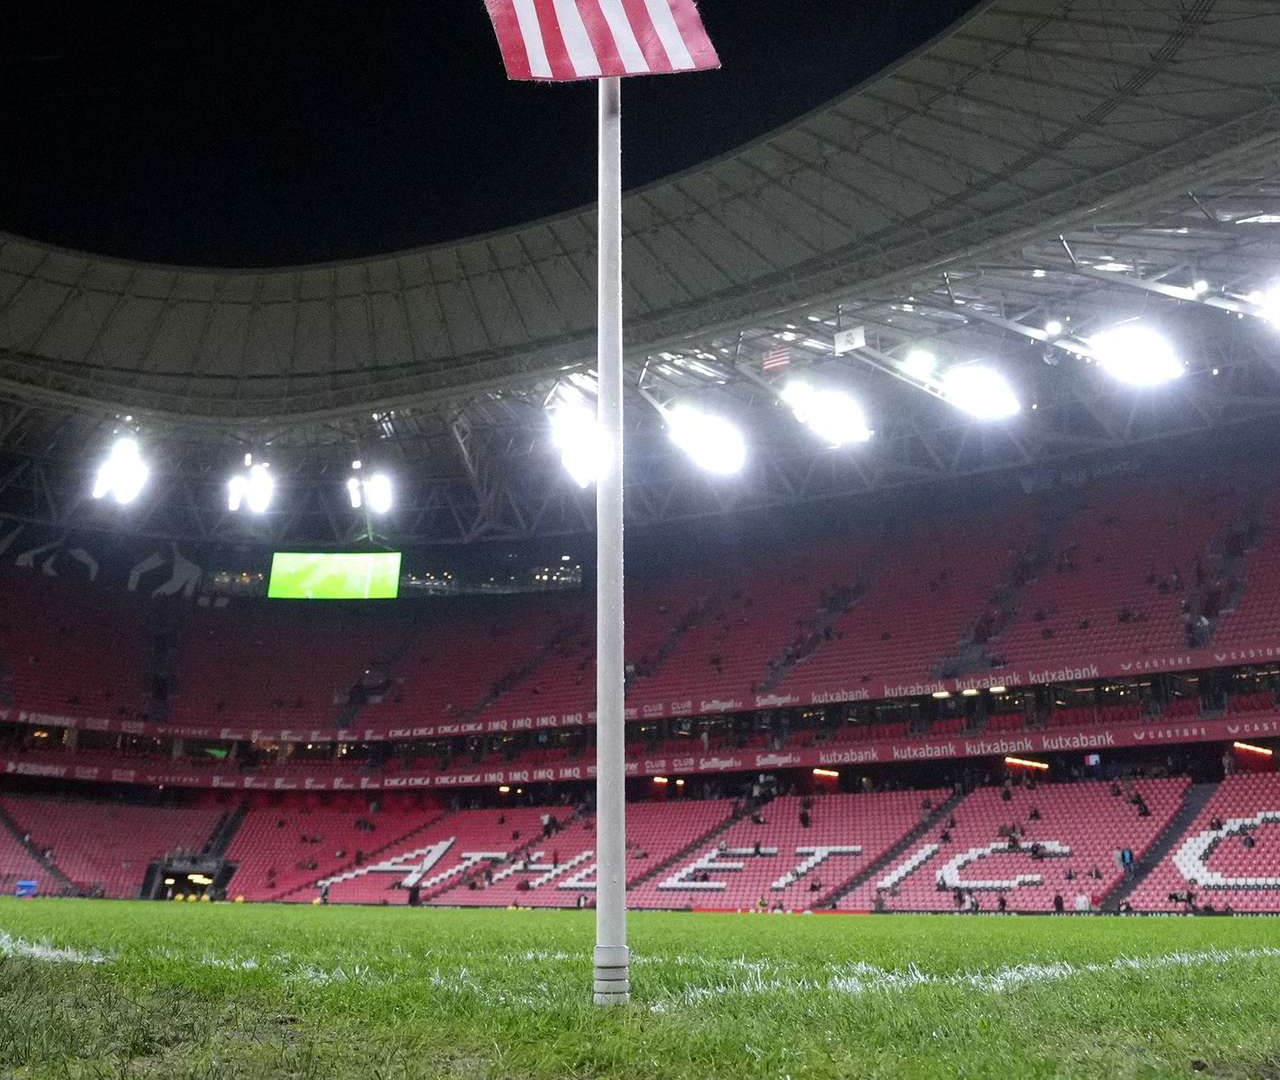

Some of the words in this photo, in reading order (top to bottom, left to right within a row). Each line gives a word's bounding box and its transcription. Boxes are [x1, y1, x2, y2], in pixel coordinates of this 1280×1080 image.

[955, 672, 1021, 691] kutxabank
[1029, 663, 1099, 684] kutxabank
[811, 688, 869, 705] kutxabank
[884, 681, 945, 699] kutxabank
[1042, 732, 1114, 751] kutxabank
[1149, 726, 1207, 739] CASTORE
[820, 748, 878, 764] kutxabank
[893, 743, 956, 759] kutxabank
[965, 738, 1032, 756] kutxabank
[316, 836, 1072, 891] ATHLETIC
